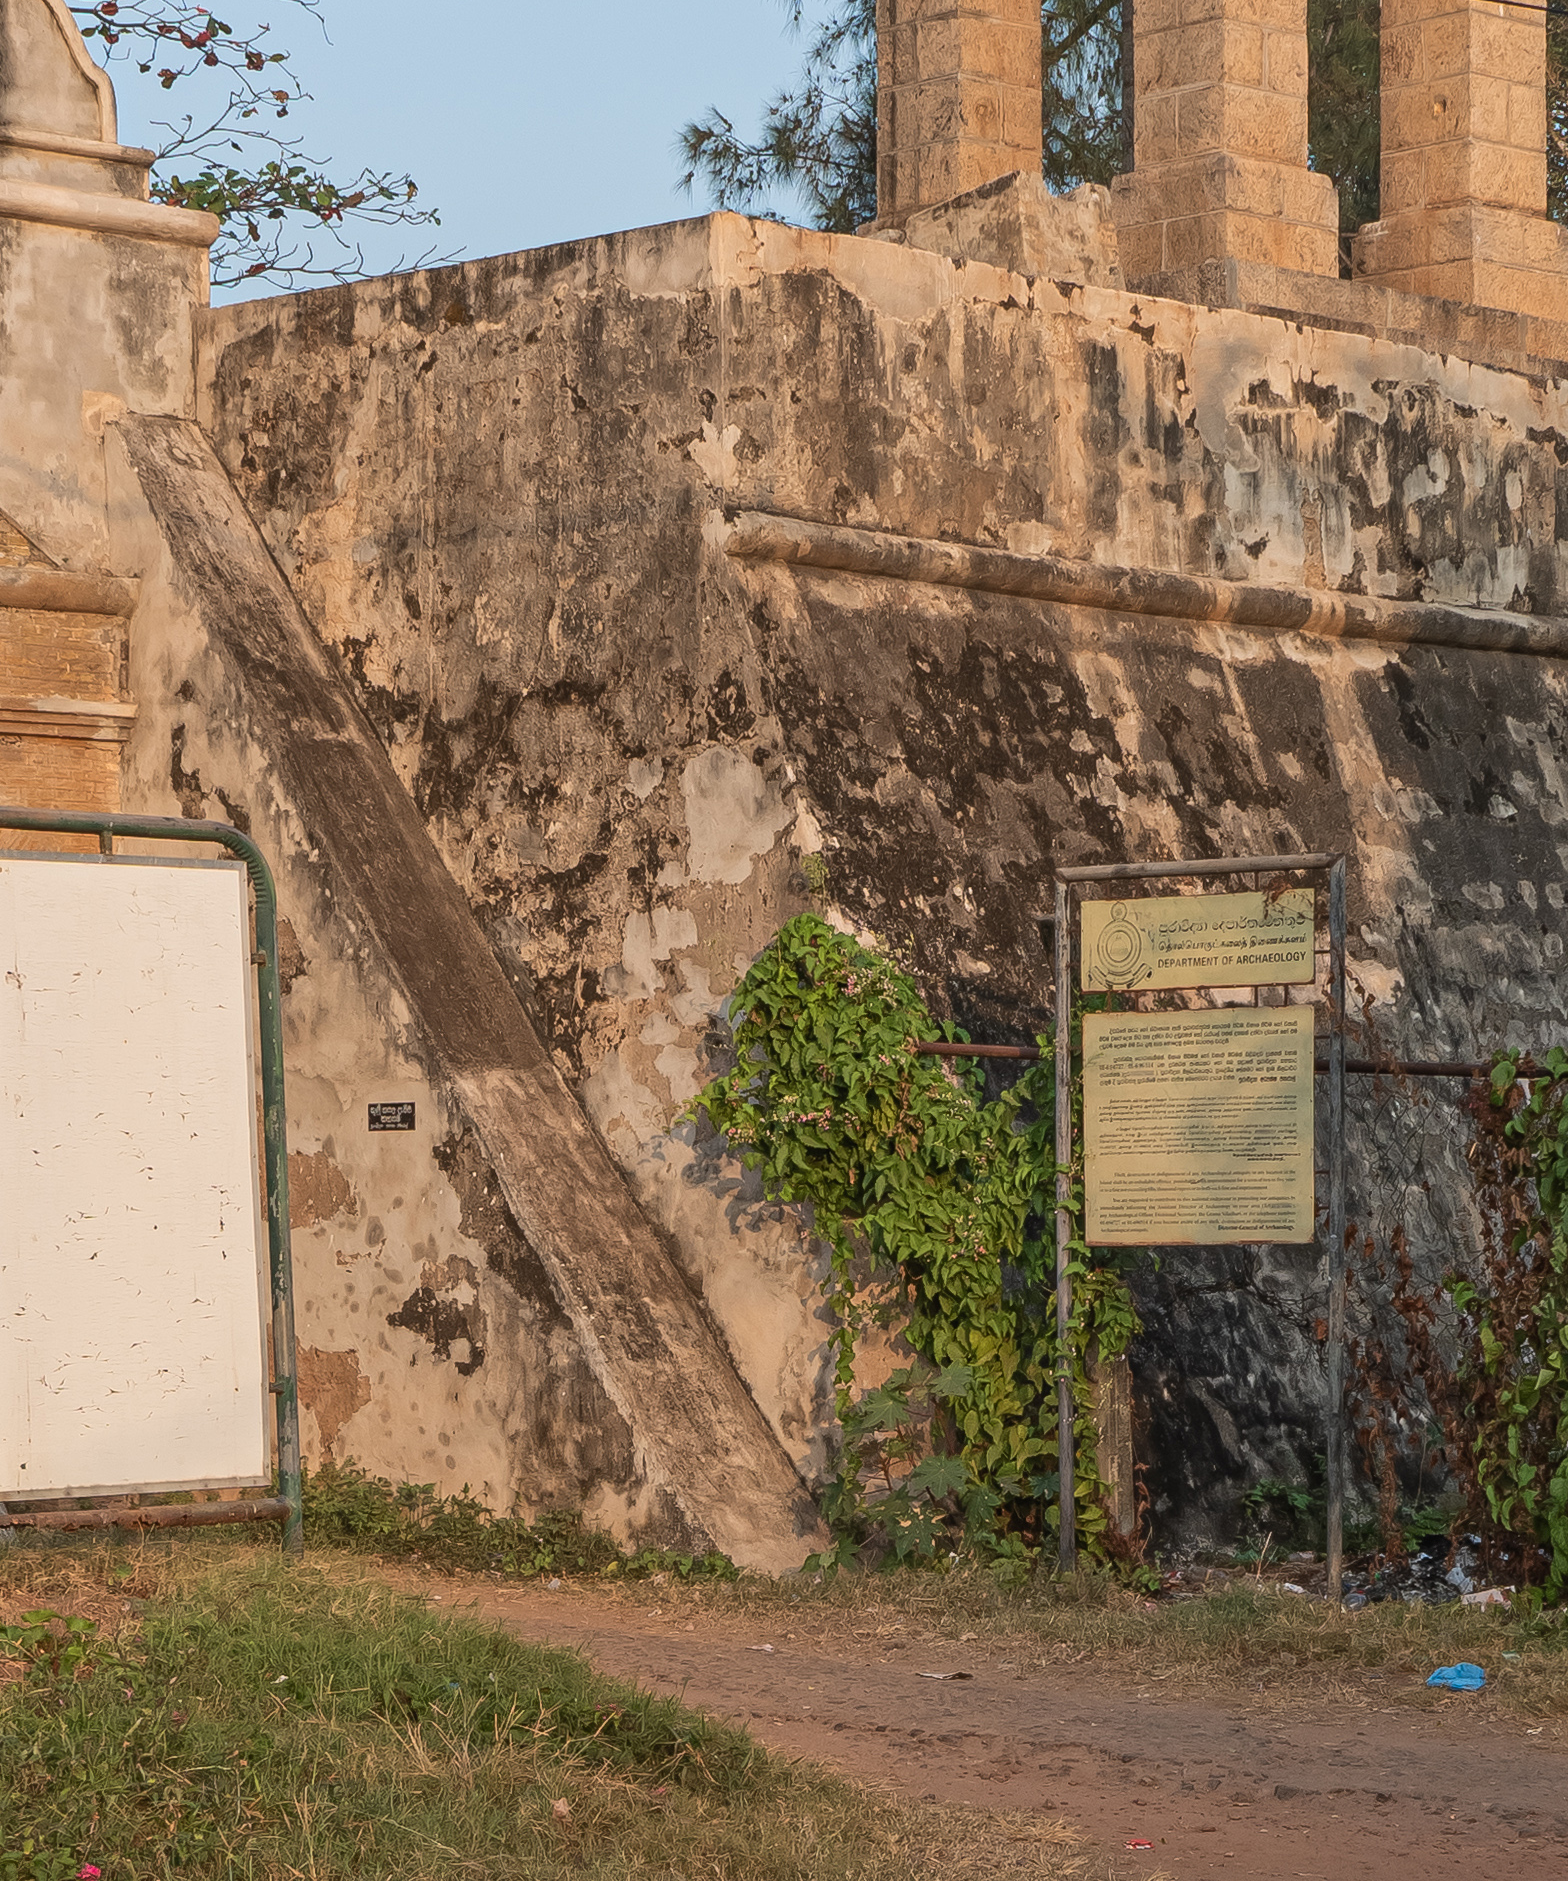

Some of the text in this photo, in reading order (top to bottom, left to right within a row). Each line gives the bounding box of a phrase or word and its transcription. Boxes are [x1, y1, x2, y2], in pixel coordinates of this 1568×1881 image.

[1158, 951, 1307, 969] DEPARTMENT OF ARCHAEOLOGY
